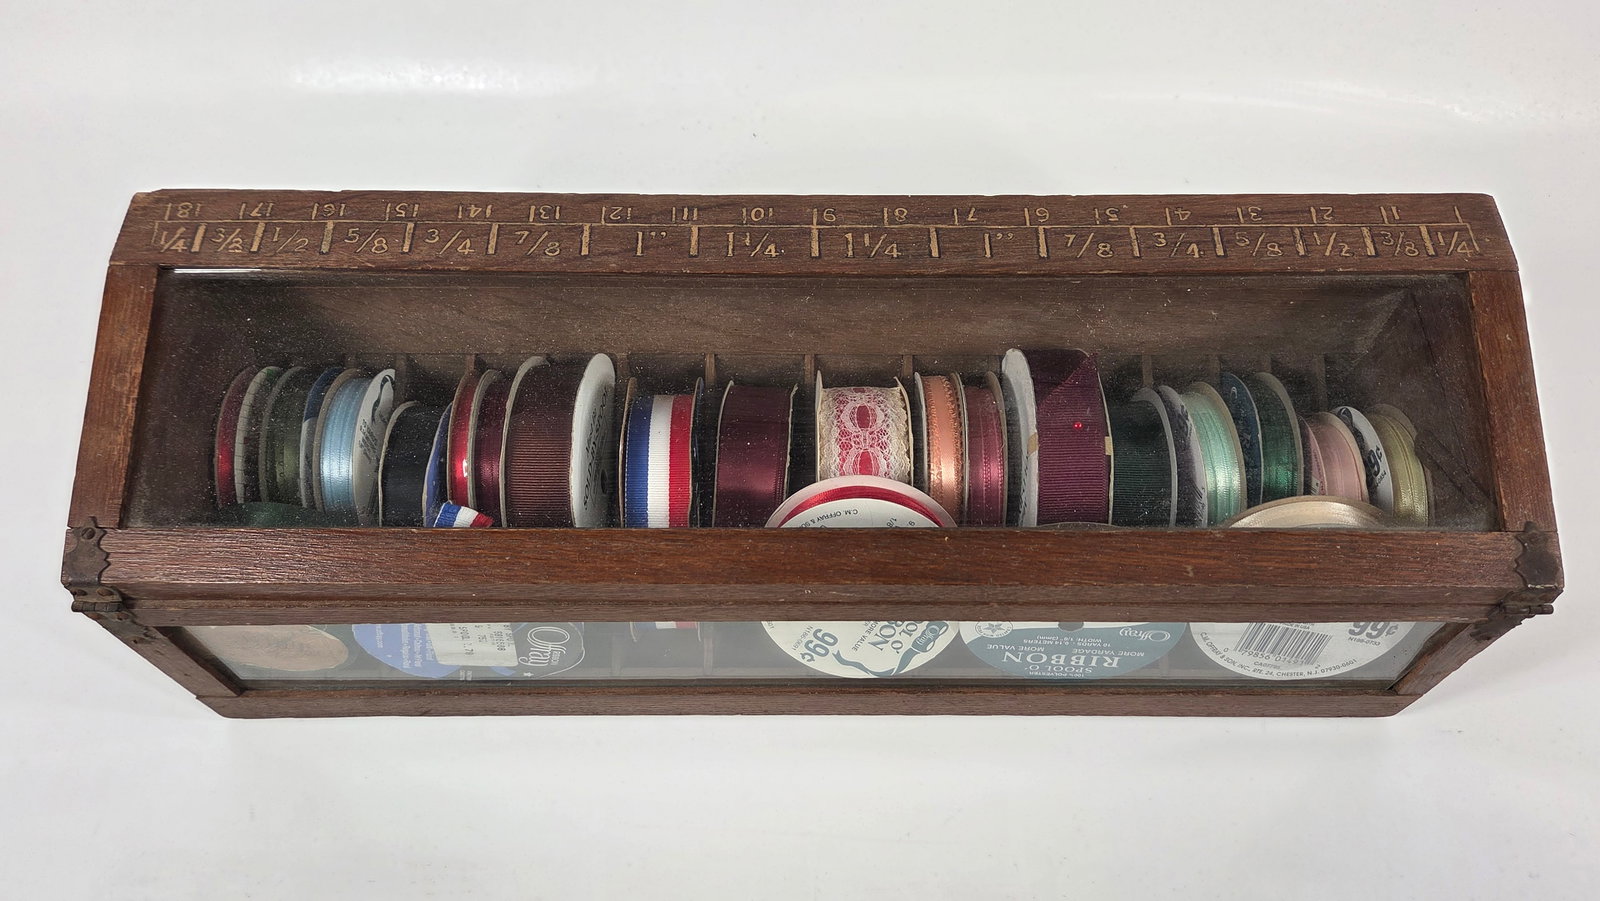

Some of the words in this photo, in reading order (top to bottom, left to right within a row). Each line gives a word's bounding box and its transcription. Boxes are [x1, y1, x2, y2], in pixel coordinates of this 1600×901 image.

[272, 227, 308, 252] 1/2
[345, 228, 388, 254] 5/8
[426, 228, 475, 255] 3/4
[515, 230, 561, 256] 7/8
[1065, 232, 1115, 259] 7/8
[1153, 232, 1204, 259] 3/4
[1235, 230, 1283, 257] 5/8
[1313, 231, 1354, 257] 1/2
[1381, 230, 1419, 257] 3/8
[1438, 230, 1470, 256] 1/4
[816, 510, 842, 523] OFFRAY
[1119, 626, 1171, 642] Offray
[986, 643, 1016, 651] VALUE
[1071, 648, 1118, 656] YARDAGE
[1001, 651, 1121, 668] RIBBON
[1044, 665, 1093, 673] SPOOL
